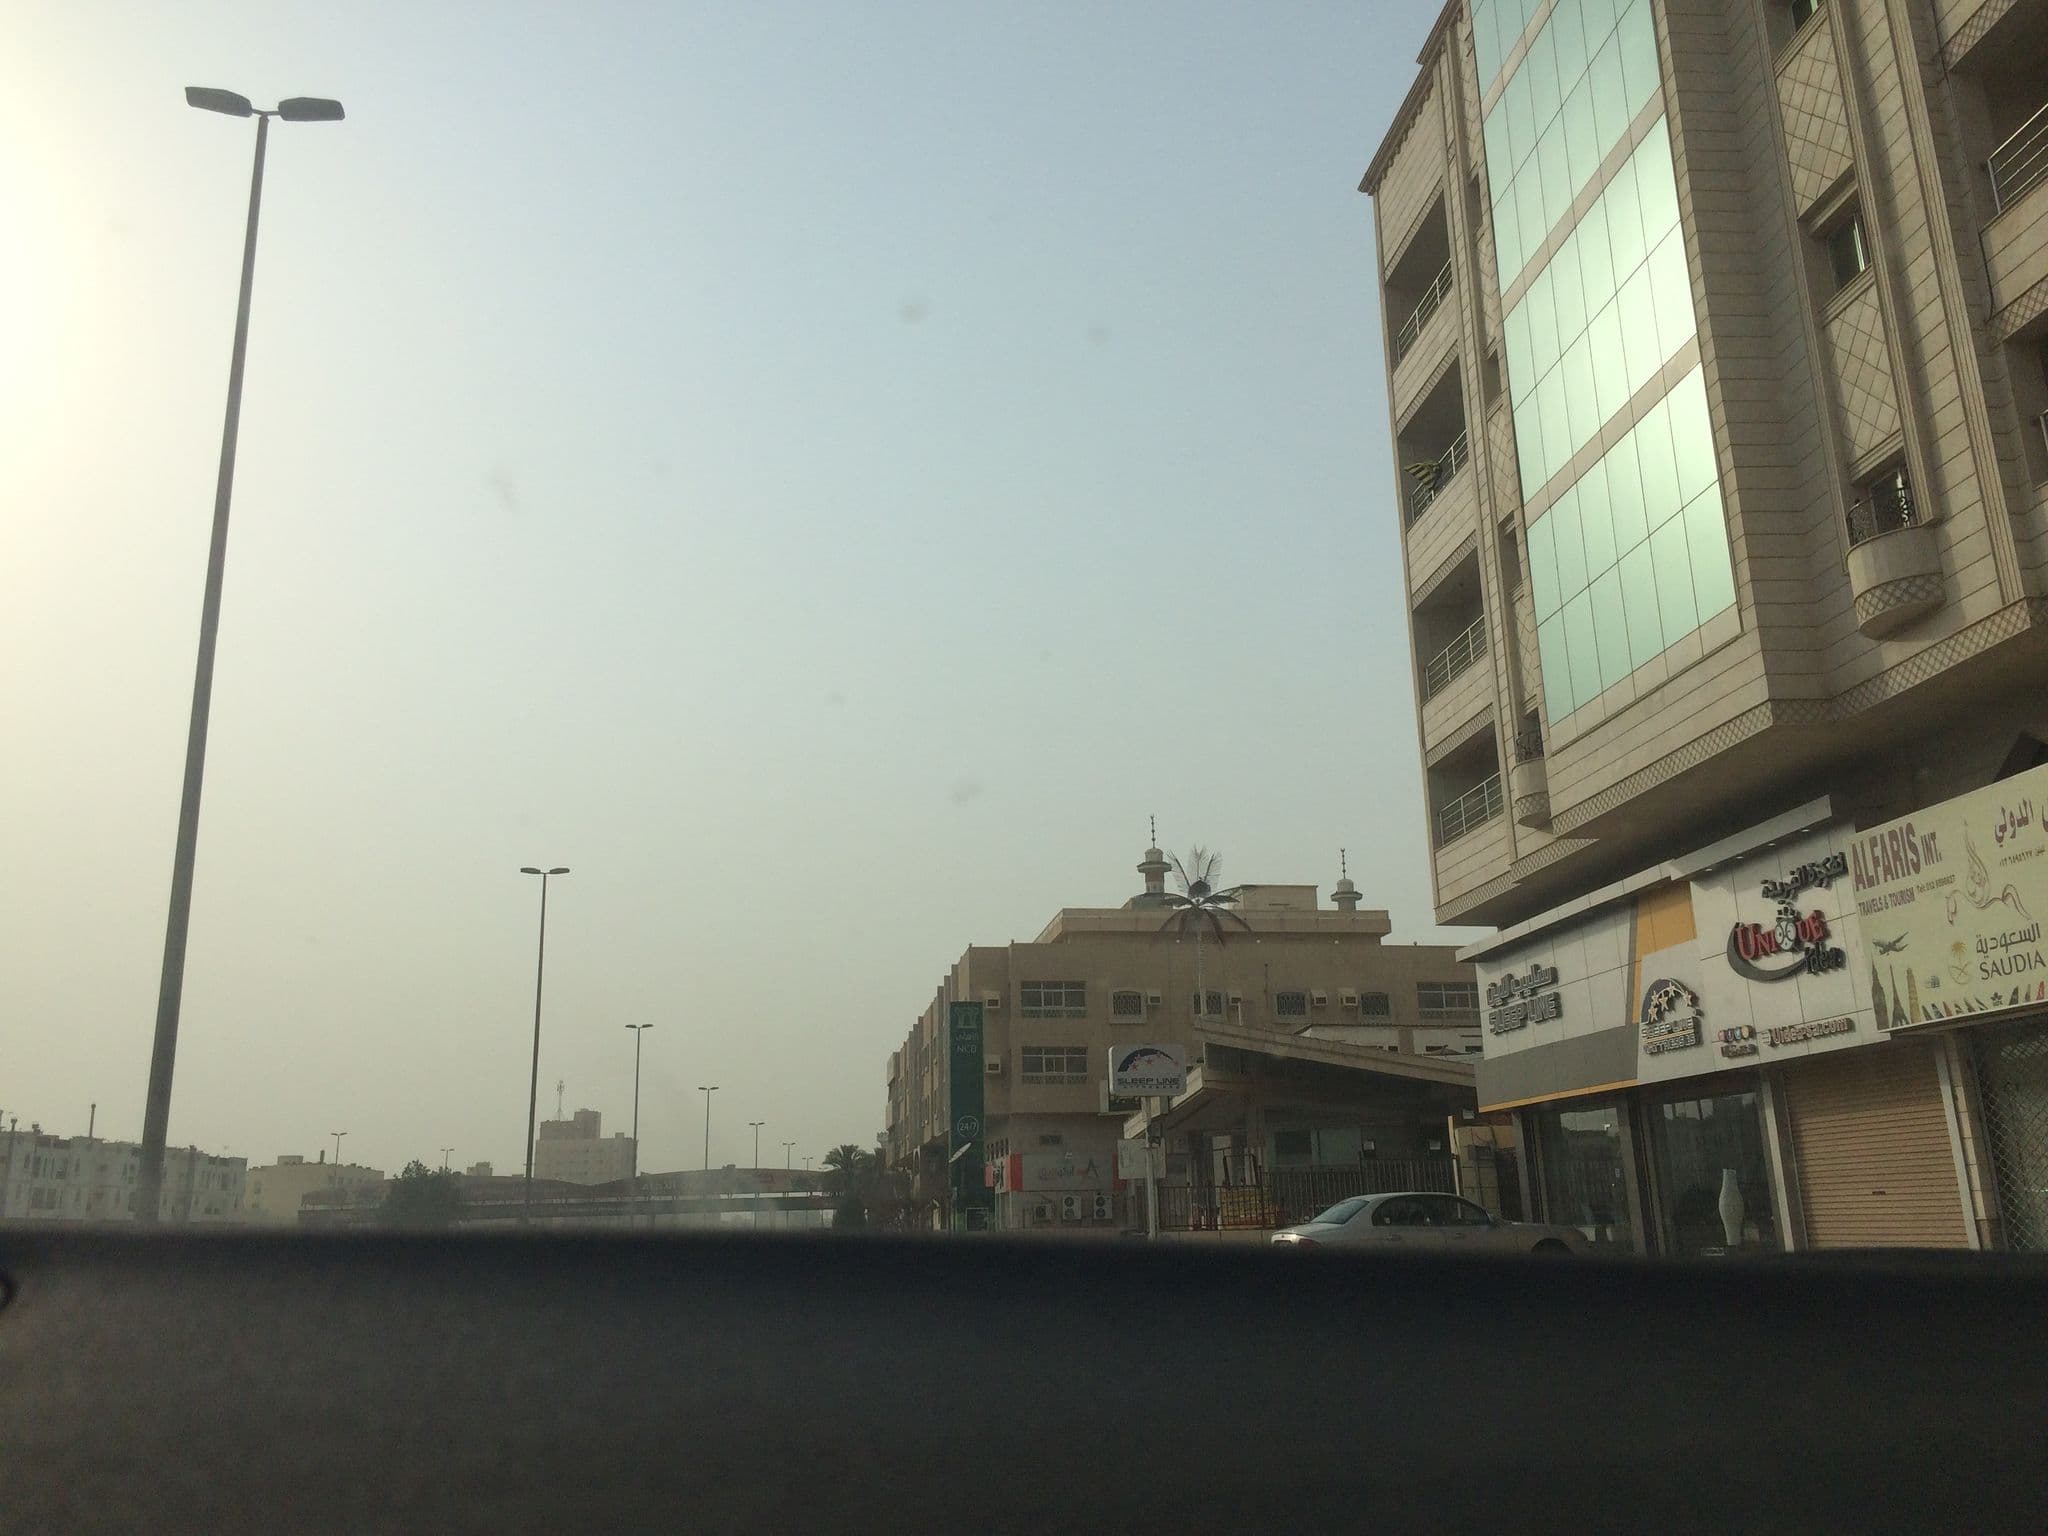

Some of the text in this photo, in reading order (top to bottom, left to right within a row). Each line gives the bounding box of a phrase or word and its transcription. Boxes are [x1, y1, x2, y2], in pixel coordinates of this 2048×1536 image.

[1850, 822, 1922, 892] ALFARIS
[1975, 922, 2041, 959] السعودية
[1979, 950, 2048, 981] SAUDIA
[1488, 992, 1562, 1034] SLEEP LINE
[1117, 1076, 1180, 1087] SLEEP LINE
